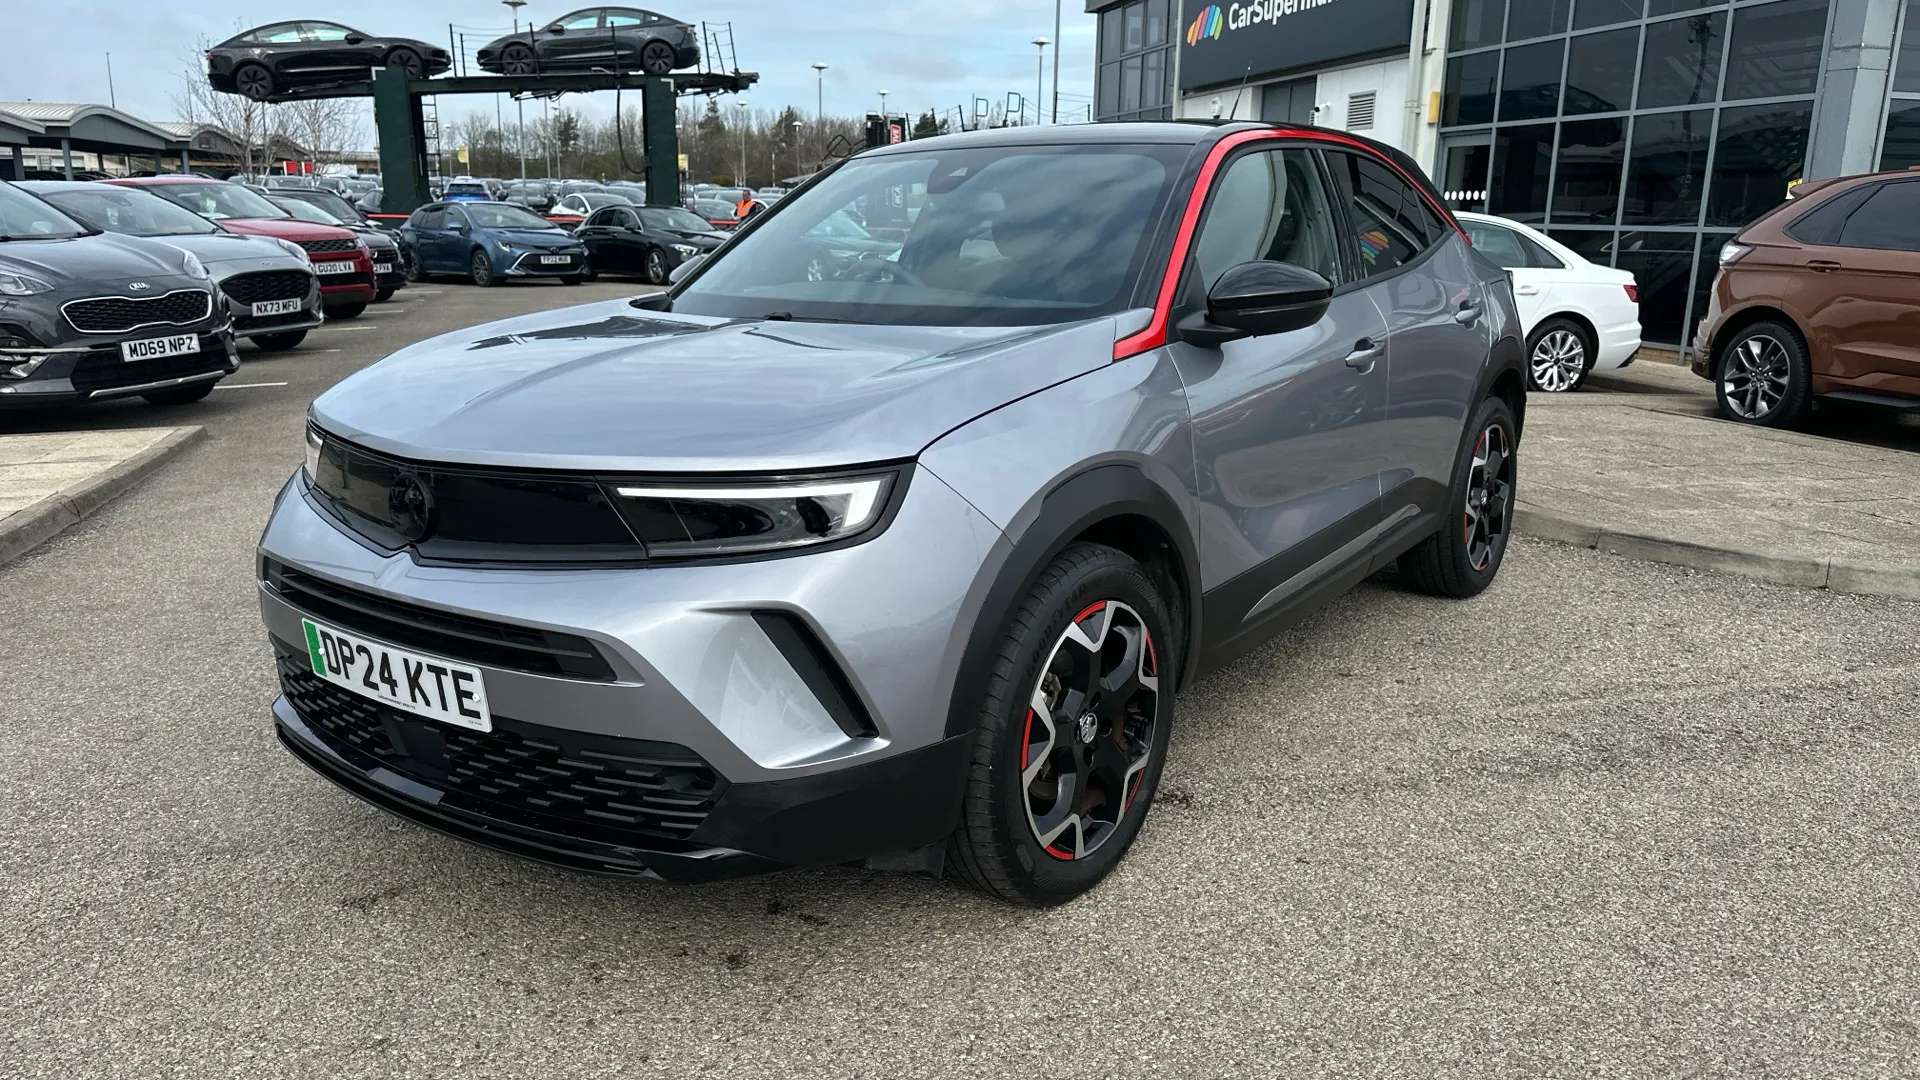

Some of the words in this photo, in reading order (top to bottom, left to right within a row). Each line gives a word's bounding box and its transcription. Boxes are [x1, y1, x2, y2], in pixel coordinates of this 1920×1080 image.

[318, 263, 337, 273] GU20
[256, 302, 280, 314] NX73
[281, 300, 298, 312] MFU
[128, 340, 166, 358] MD69
[168, 336, 196, 353] NPZ
[320, 629, 398, 697] DP24
[402, 657, 482, 720] KTE
